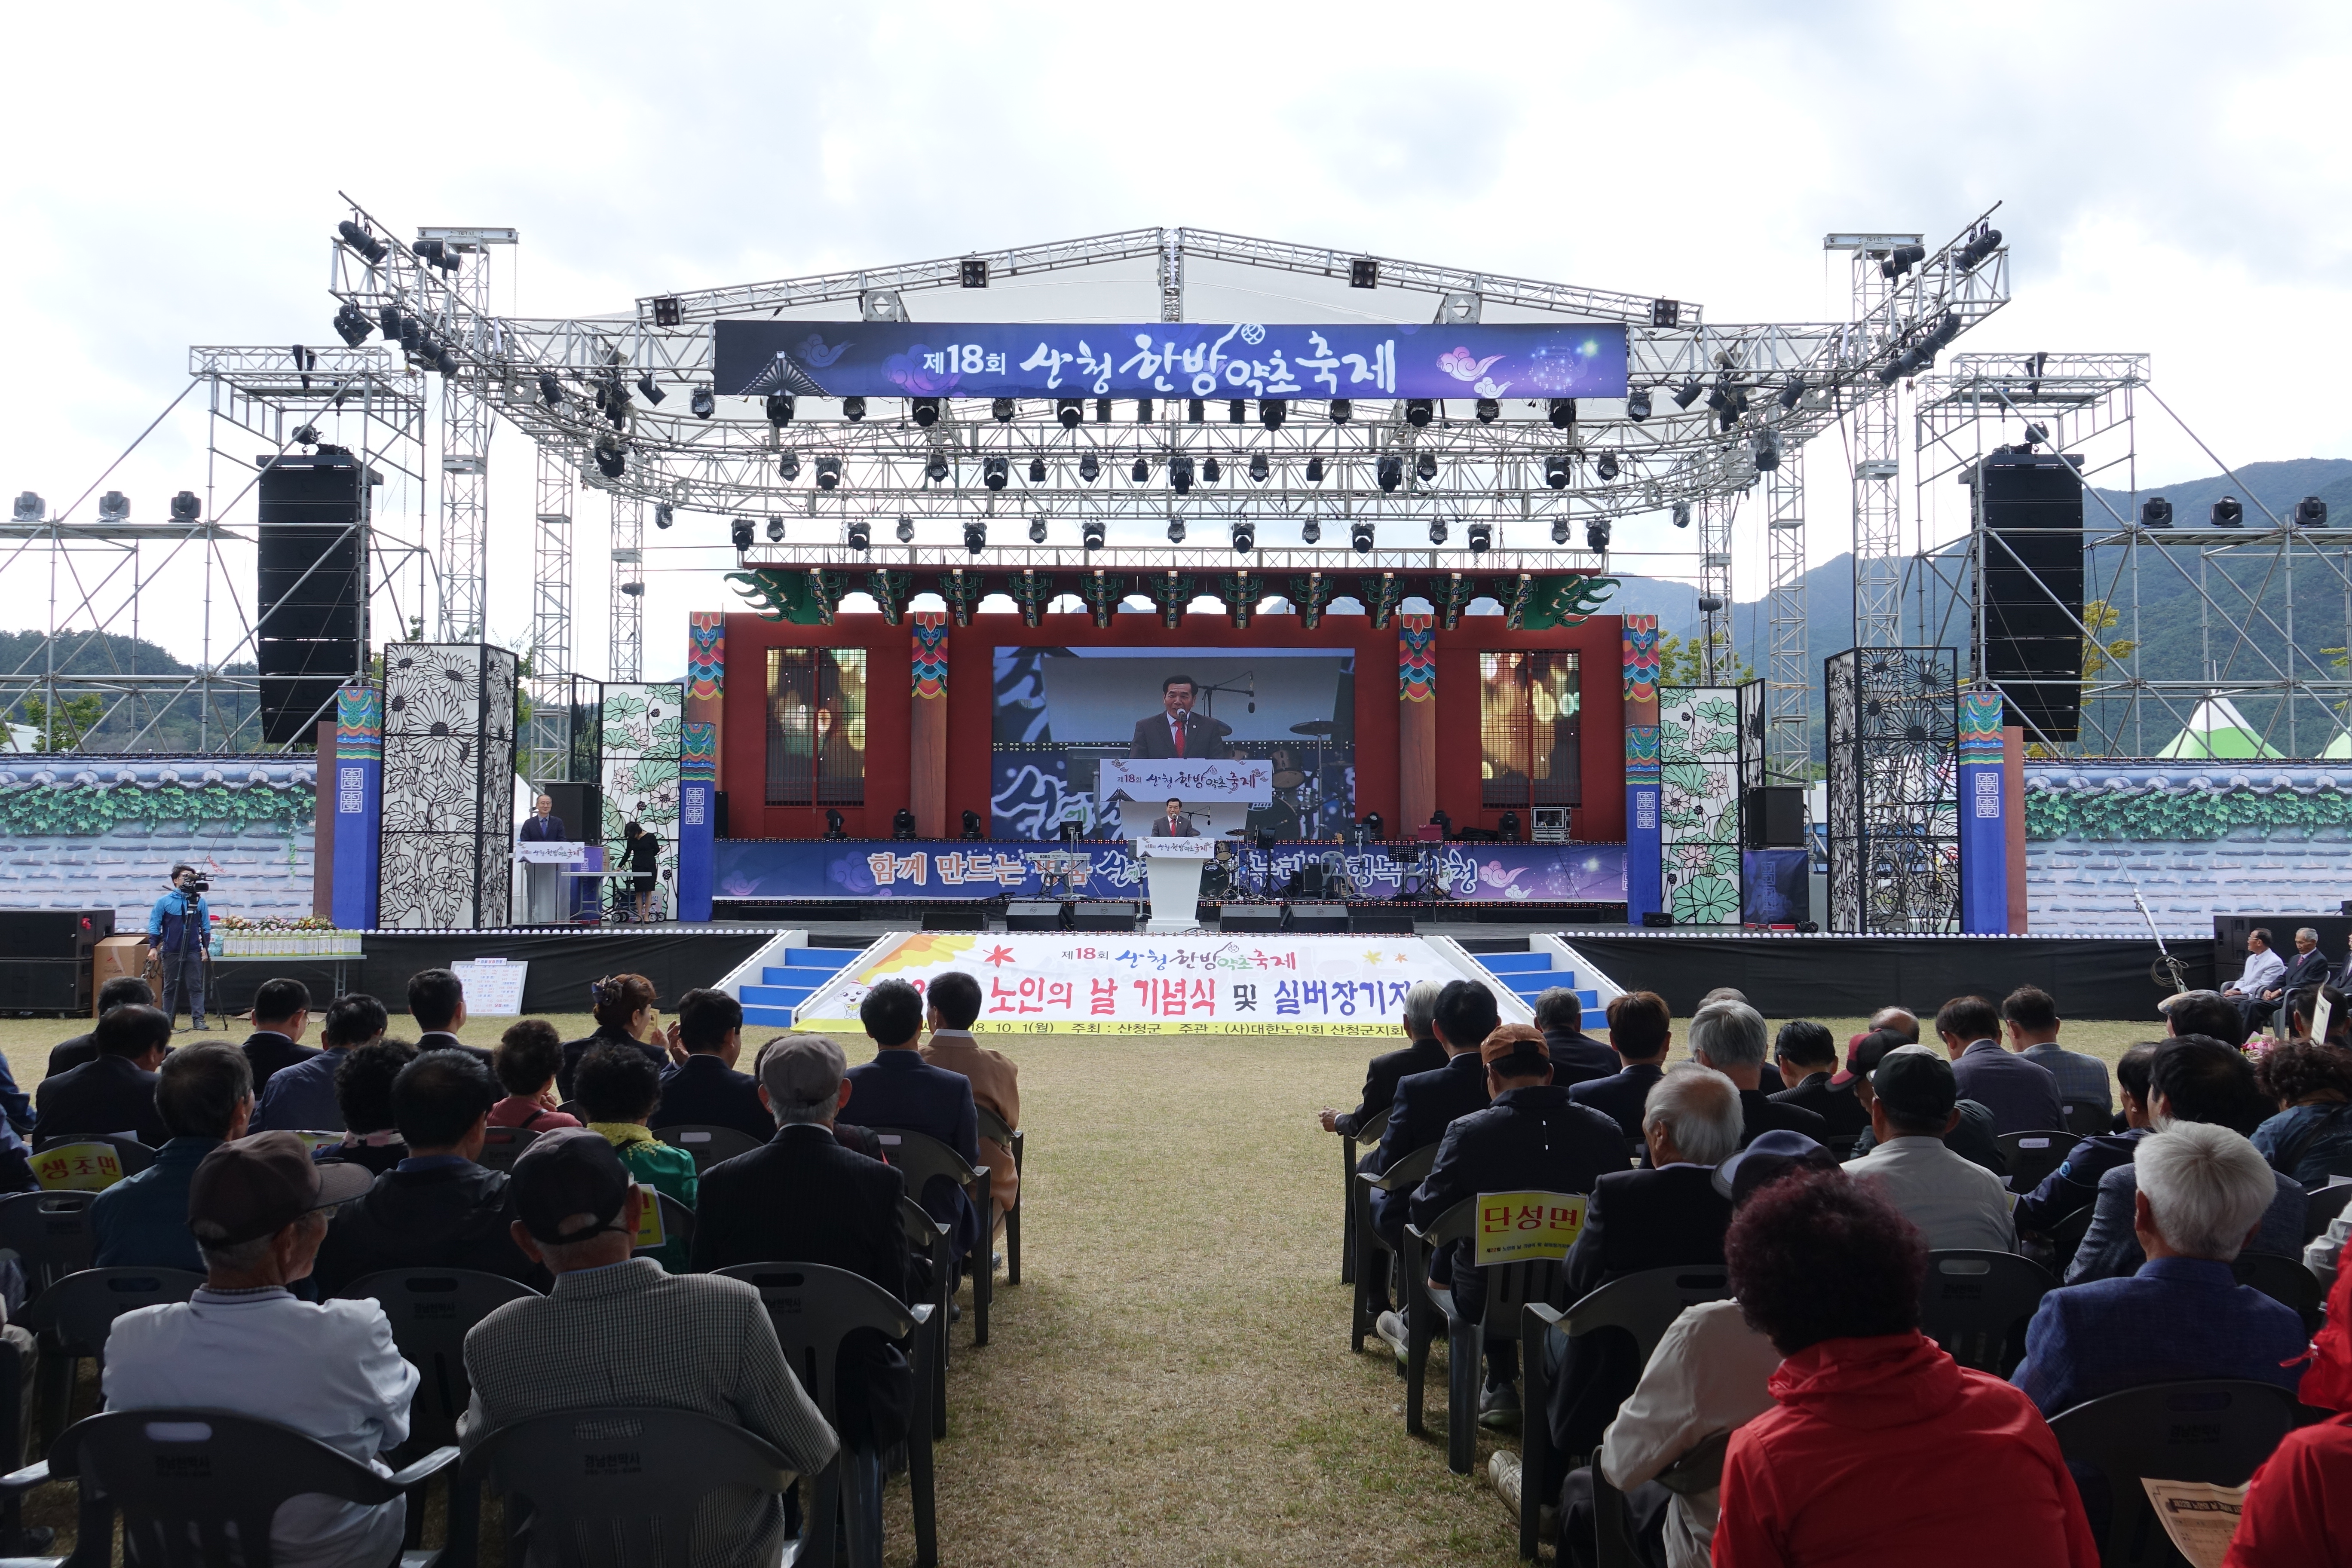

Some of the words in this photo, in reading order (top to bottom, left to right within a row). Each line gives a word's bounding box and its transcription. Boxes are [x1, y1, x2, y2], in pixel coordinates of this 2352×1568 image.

[923, 344, 1006, 375] 제18회
[1019, 339, 1112, 394] 산청
[1117, 774, 1142, 784] 제18회
[1145, 773, 1173, 789] 산청
[867, 851, 927, 886] 함께
[936, 852, 1027, 887] 만드는
[1061, 947, 1109, 960] 제18회
[1115, 949, 1167, 971] 산청
[989, 976, 1073, 1014] 노인의
[1090, 977, 1118, 1015] 날
[1133, 977, 1216, 1016] 기념식
[1233, 983, 1257, 1011] 및
[1274, 980, 1412, 1016] 실버장기자
[995, 1023, 1016, 1032] 10.
[1023, 1022, 1054, 1033] 1(월)
[1071, 1023, 1100, 1033] 주최
[1118, 1023, 1162, 1034] 산청군
[1179, 1023, 1209, 1034] 주관
[1225, 1023, 1324, 1035] (사)대한노인회
[1331, 1024, 1404, 1037] 산청군지회
[42, 1155, 119, 1180] 생초면
[1485, 1205, 1578, 1233] 단성면
